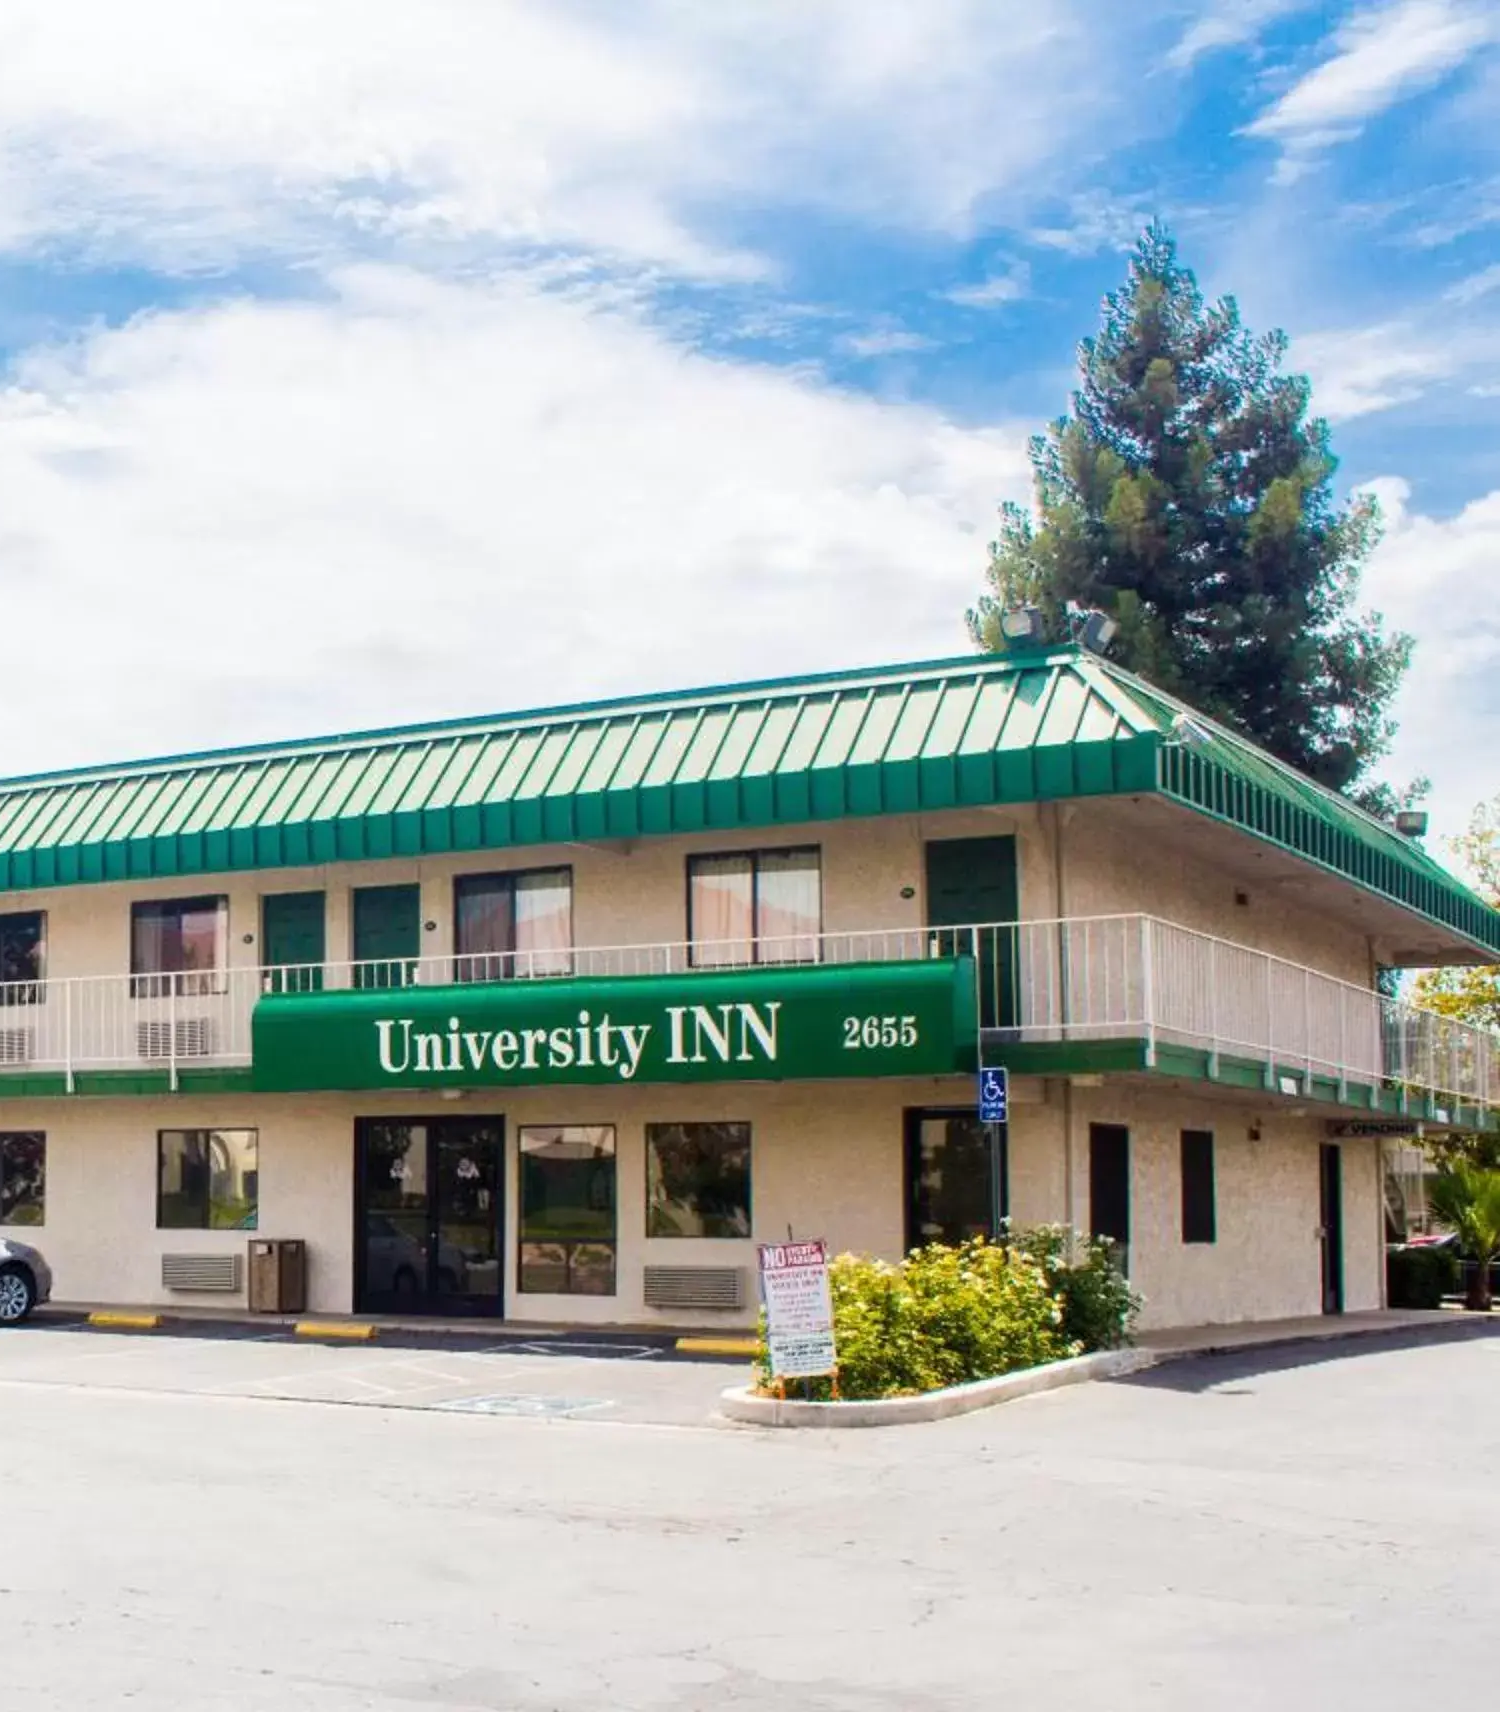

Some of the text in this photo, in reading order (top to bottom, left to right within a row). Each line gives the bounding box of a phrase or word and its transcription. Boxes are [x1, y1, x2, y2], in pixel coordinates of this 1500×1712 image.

[375, 1002, 918, 1079] University INN 2655
[762, 1247, 786, 1268] NO
